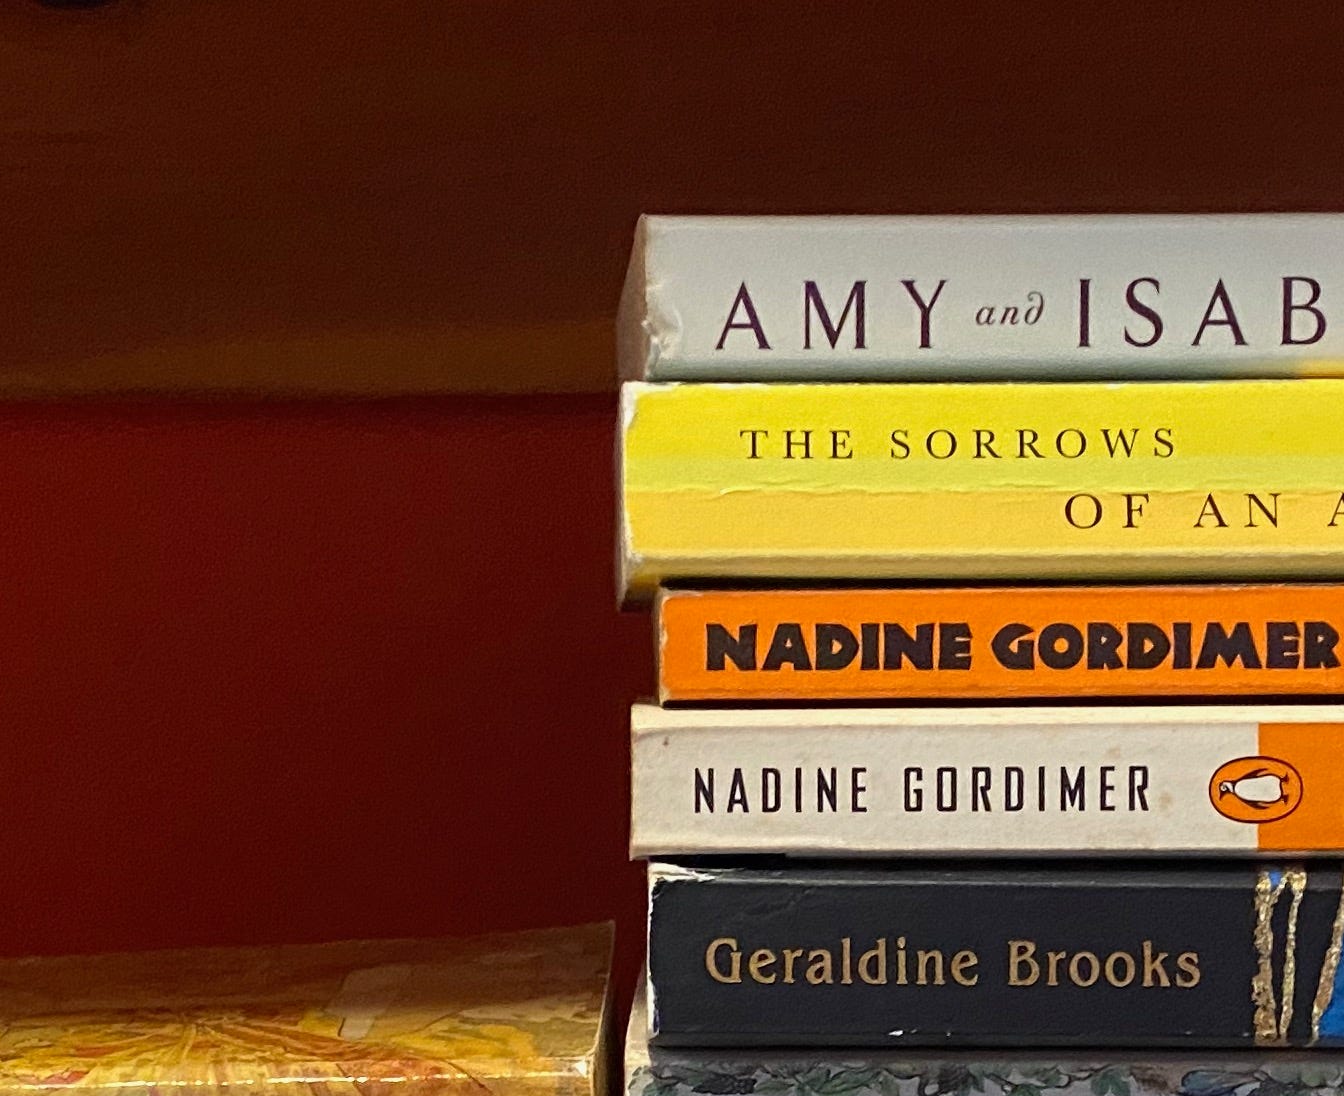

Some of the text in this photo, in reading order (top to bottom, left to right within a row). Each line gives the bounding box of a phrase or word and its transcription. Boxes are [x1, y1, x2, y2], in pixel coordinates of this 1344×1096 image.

[715, 278, 950, 352] AMY
[974, 290, 1046, 327] and
[740, 427, 1177, 460] THE SORROWS
[1064, 493, 1153, 530] OF
[1193, 493, 1282, 529] AN
[706, 621, 1342, 672] NADINE GORDIMER
[693, 764, 1151, 815] NADINE GORDIMER
[706, 937, 1202, 989] Geraldine Brooks
